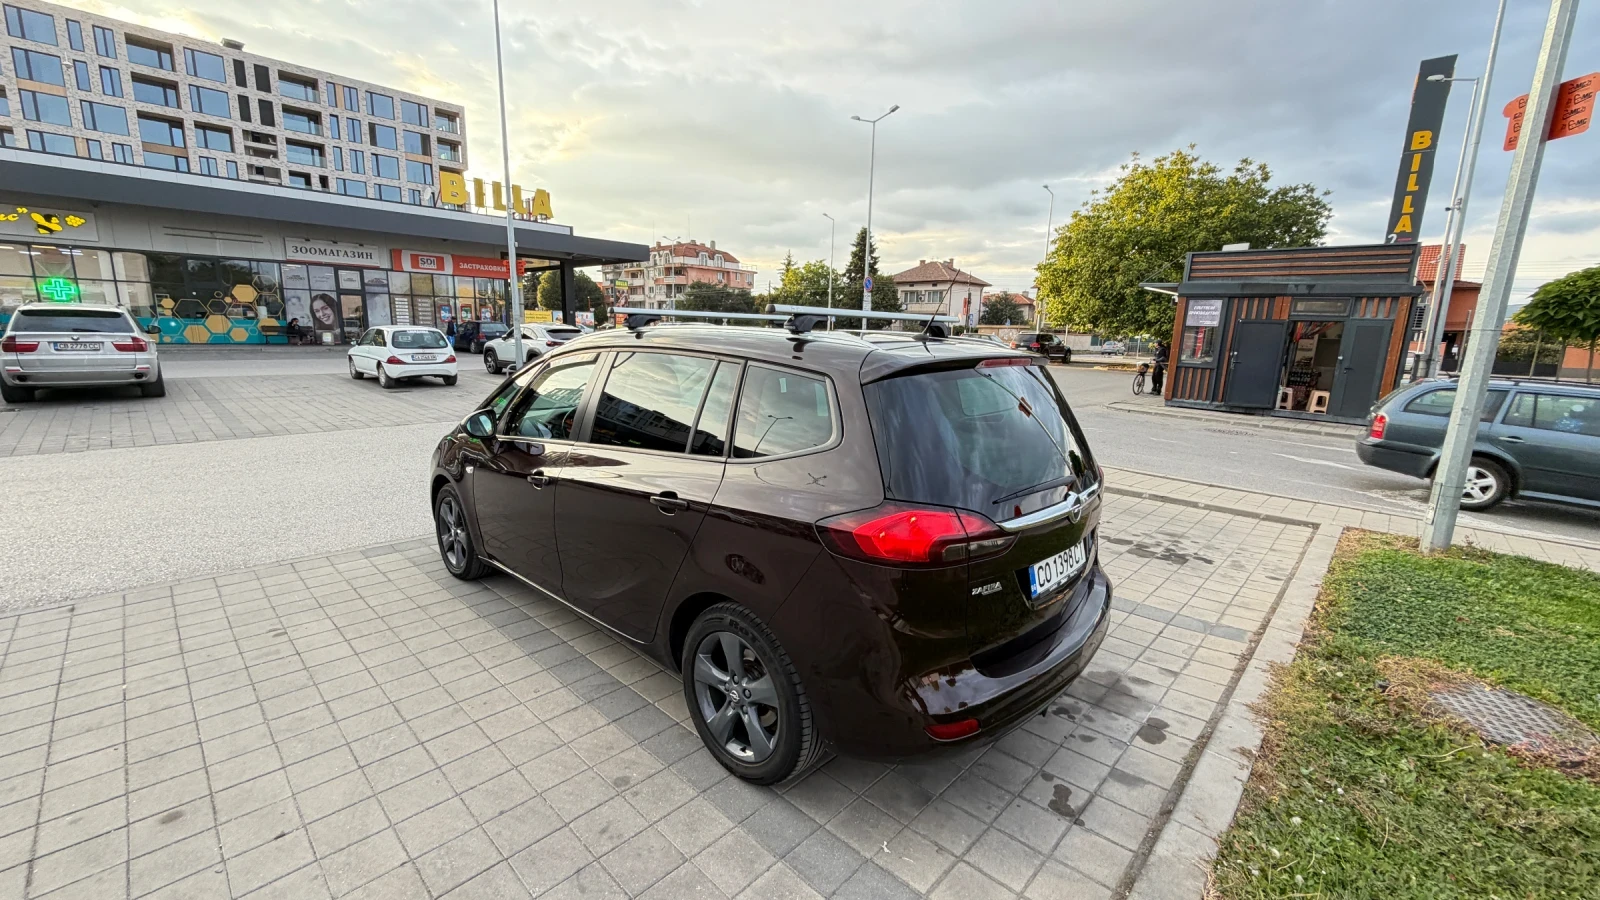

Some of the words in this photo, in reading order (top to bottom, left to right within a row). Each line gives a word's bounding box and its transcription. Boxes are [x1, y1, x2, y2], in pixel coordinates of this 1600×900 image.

[1394, 130, 1433, 233] BILLA
[439, 171, 554, 219] BILLA
[292, 245, 373, 260] ЗООМАГАЗИН
[420, 257, 436, 266] SDI
[459, 262, 507, 273] ЗАСТРАХОВКИ
[1037, 562, 1052, 588] CO
[1053, 548, 1074, 578] 1398
[972, 581, 1002, 596] ZAFIRA
